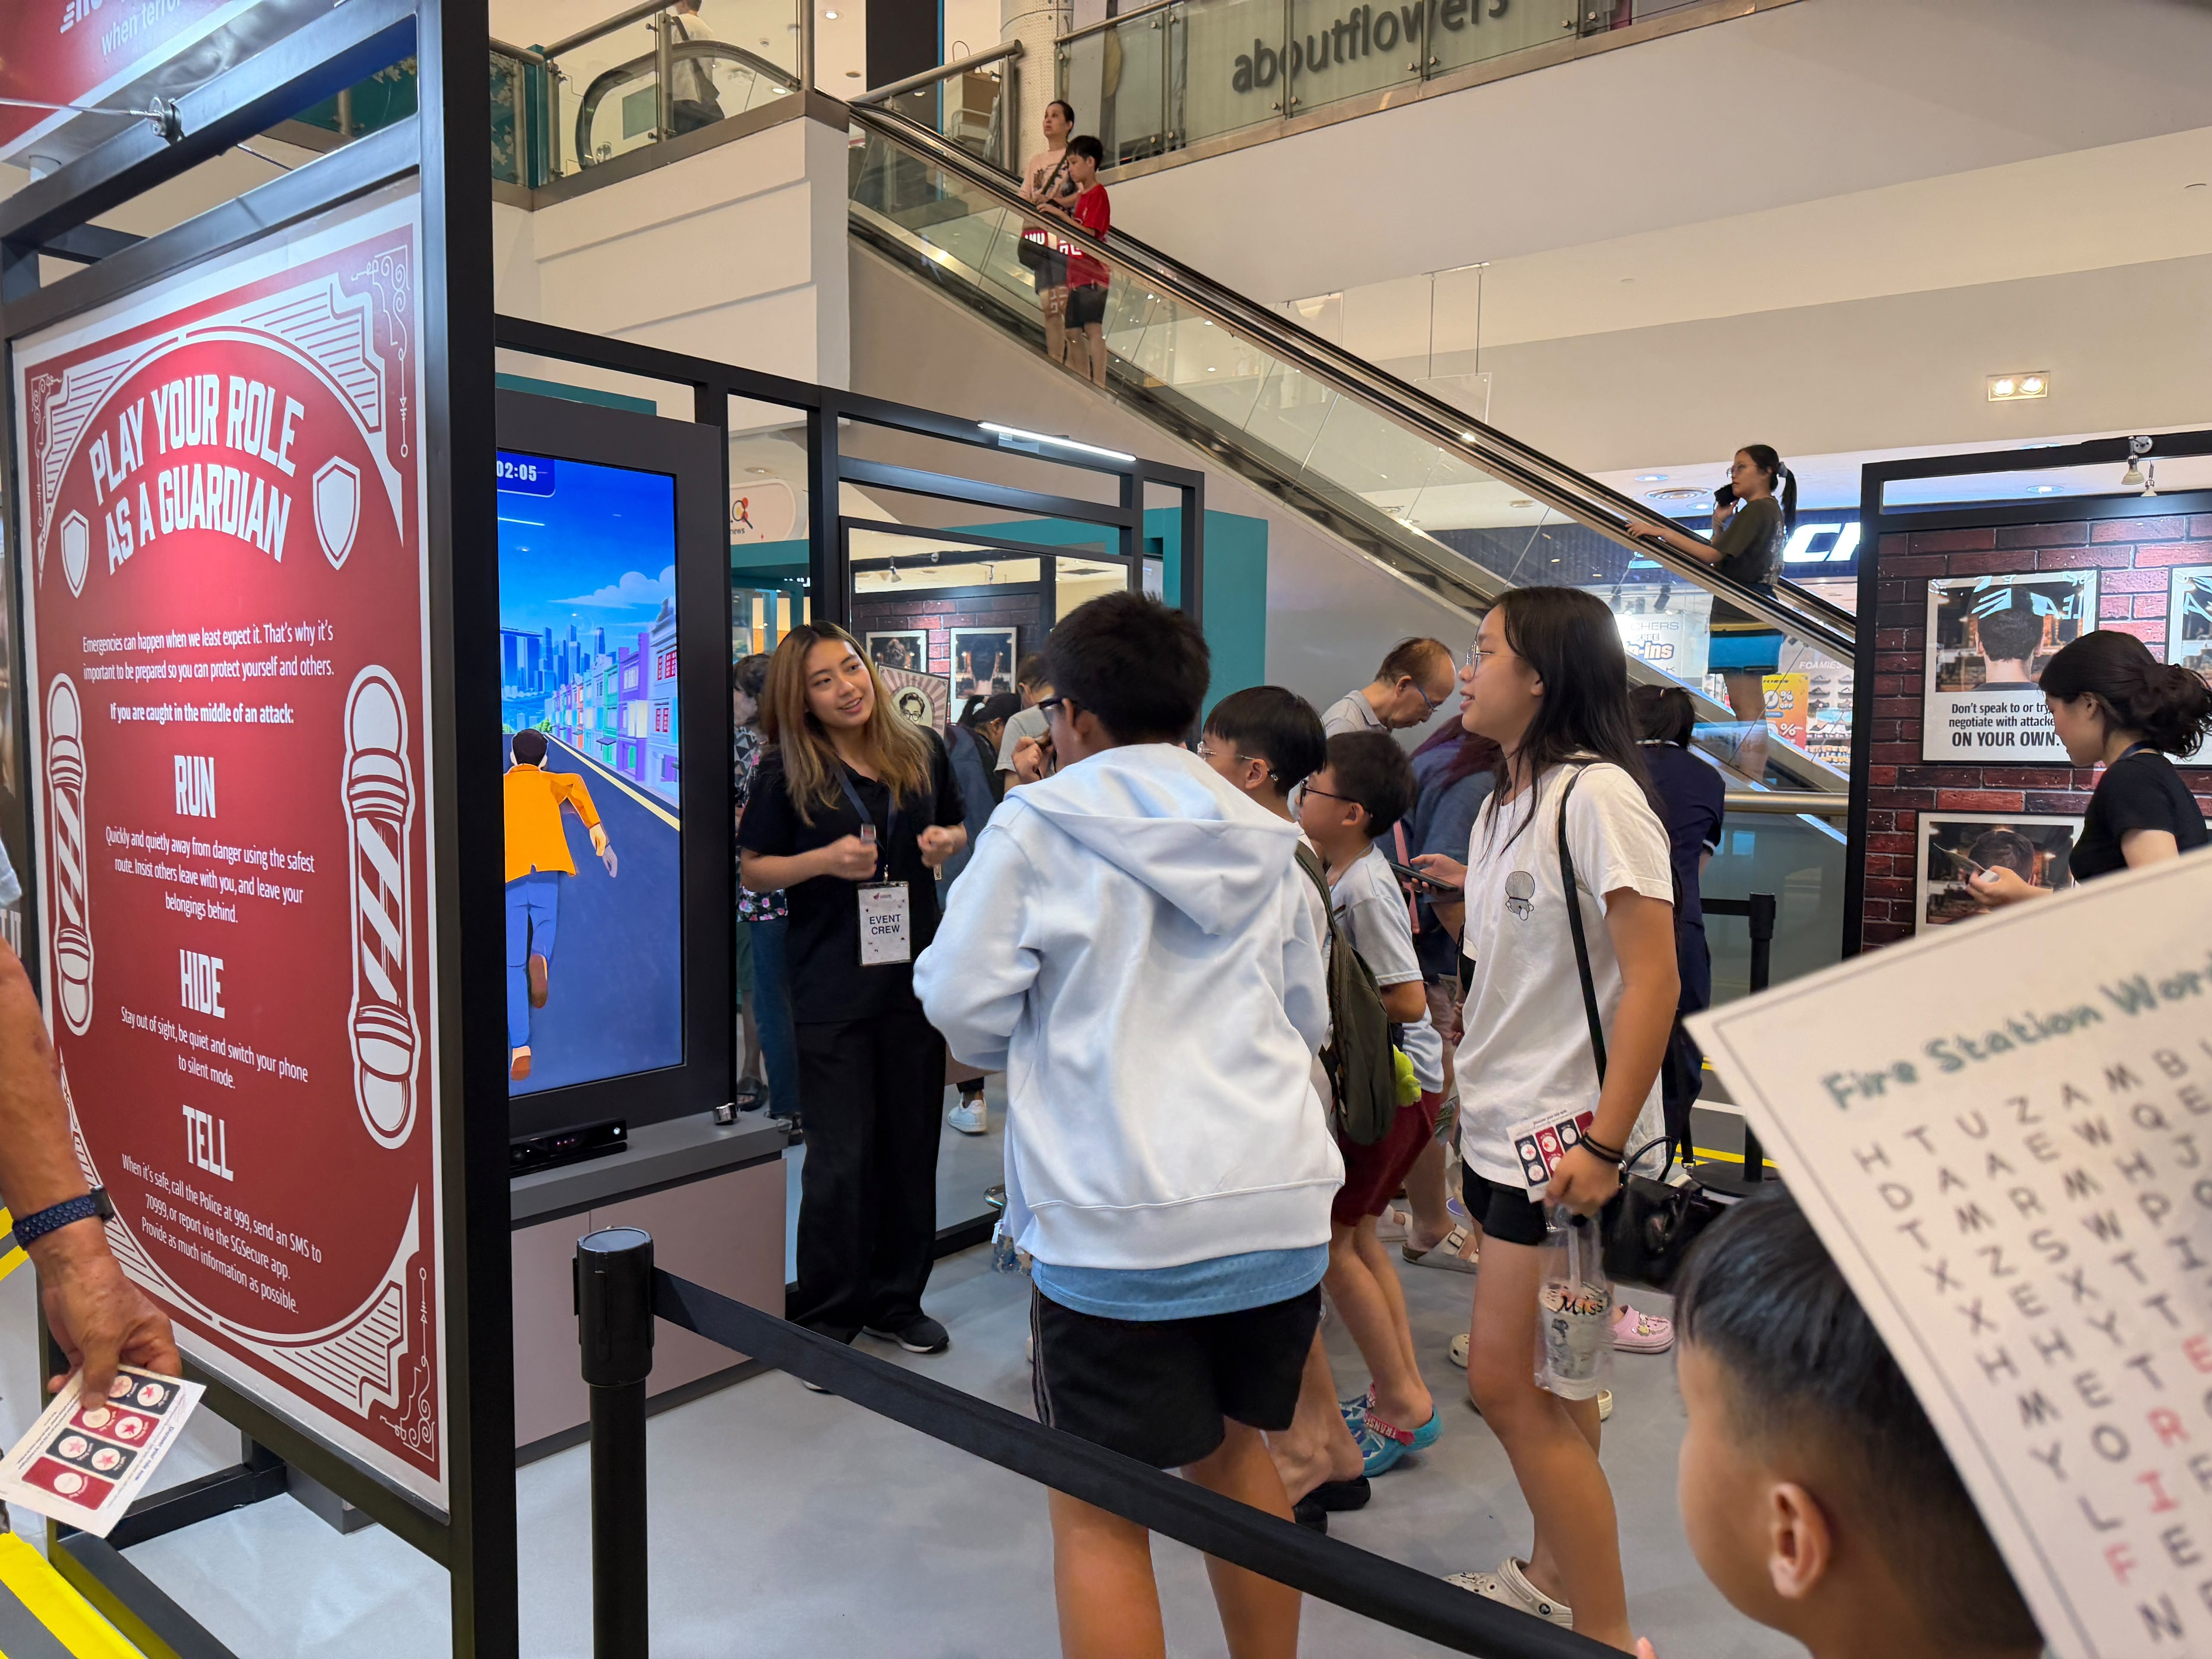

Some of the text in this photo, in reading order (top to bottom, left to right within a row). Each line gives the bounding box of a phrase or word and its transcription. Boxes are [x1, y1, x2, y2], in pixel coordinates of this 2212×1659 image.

[102, 14, 138, 56] when
[89, 375, 305, 506] PLAY YOUR ROLE
[496, 461, 537, 481] 02:05
[105, 464, 292, 575] AS A GUARDIAN
[83, 619, 334, 655] Emergencies can happen when we least expect it. That's why it's
[83, 654, 334, 683] important to be prepared so you can protect yourself and others.
[110, 702, 294, 725] If you are caught in the middle of an attack:
[1949, 716, 2055, 729] negotiate with attacke
[1952, 702, 2049, 715] Don't speak to or try
[1952, 731, 2060, 747] ON YOUR OWN.
[174, 755, 216, 818] RUN
[106, 826, 315, 873] Quickly and quietly away from danger using the safest
[114, 858, 303, 906] route. Insist others leave with you, and leave your
[165, 891, 238, 923] belongings behind.
[869, 914, 901, 924] EVENT
[871, 925, 900, 935] CREW
[179, 949, 225, 1019] HIDE
[121, 1006, 308, 1083] Stay out of sight, be quiet and switch your phone
[1823, 951, 2212, 1109] Fire Station Wor
[178, 1054, 235, 1089] to silent mode.
[1853, 1049, 2188, 1173] H T U Z A M B
[183, 1104, 234, 1182] TELL
[1878, 1085, 2212, 1210] D A A E W Q E
[122, 1153, 322, 1263] When it's safe, call the Police at 999, send an SMS to
[1897, 1134, 2200, 1249] T M R M H J
[142, 1216, 299, 1314] Provide as much information as possible.
[145, 1193, 291, 1281] 70999, or report via the SGSecure app.
[2030, 1408, 2190, 1482] Y O R
[2077, 1471, 2180, 1532] L I
[2104, 1526, 2202, 1586] F E
[2137, 1593, 2183, 1643] N
